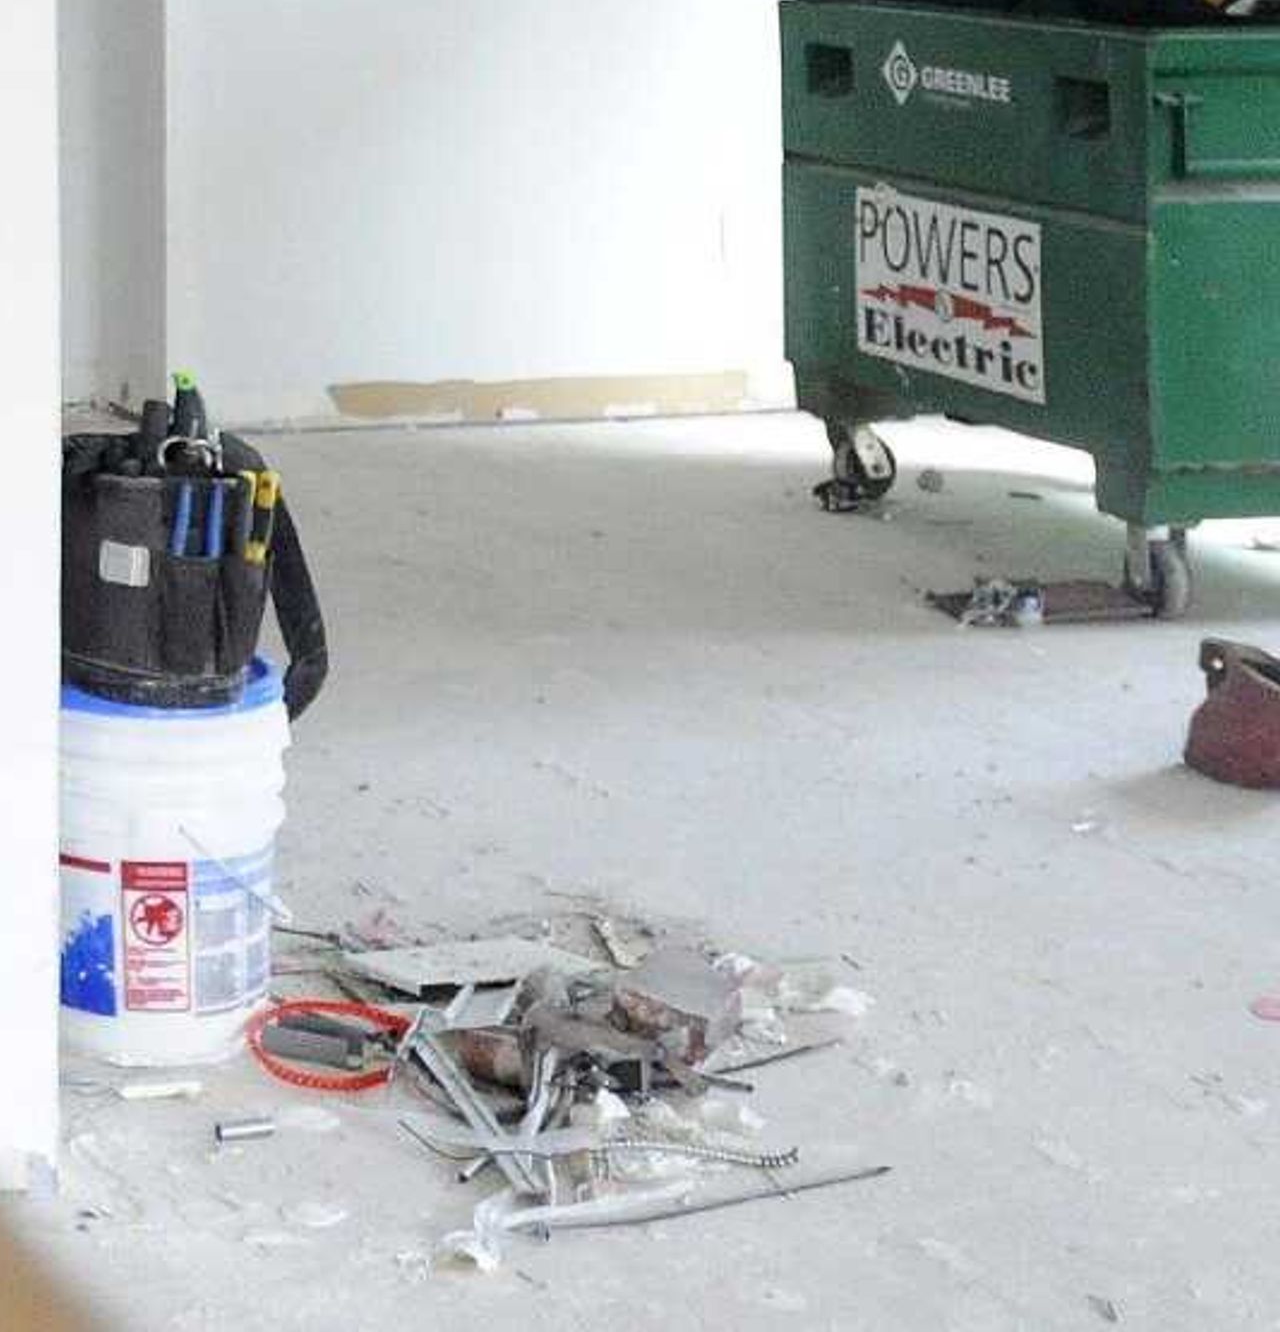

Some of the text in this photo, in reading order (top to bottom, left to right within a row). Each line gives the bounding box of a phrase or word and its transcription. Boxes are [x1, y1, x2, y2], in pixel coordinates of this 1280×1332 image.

[920, 66, 1012, 103] GREENLEE
[859, 198, 1035, 304] POWERS
[864, 306, 1038, 391] Electric
